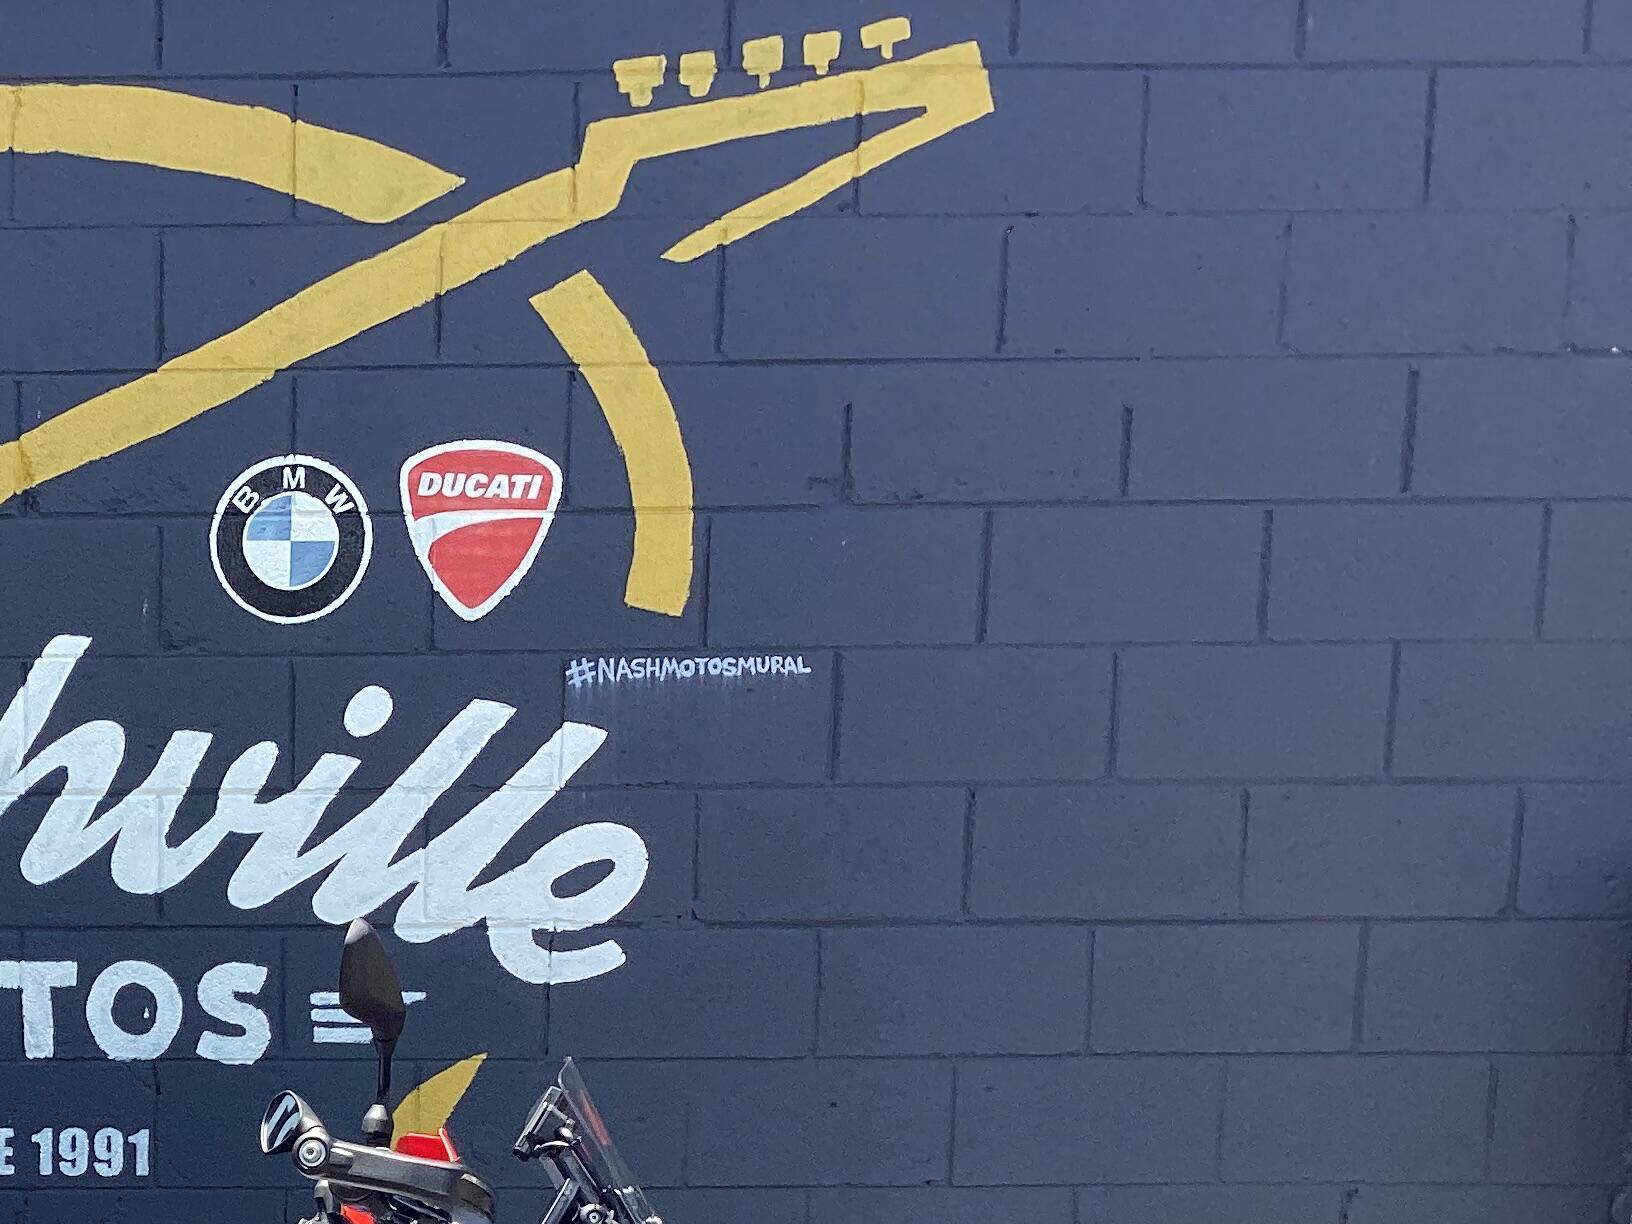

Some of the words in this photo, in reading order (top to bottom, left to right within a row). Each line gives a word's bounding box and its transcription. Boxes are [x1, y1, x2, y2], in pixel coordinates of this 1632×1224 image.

[232, 467, 355, 514] BMW
[418, 472, 543, 500] DUCATI
[565, 656, 812, 689] #NASHMOTOSMURAL
[32, 1127, 150, 1176] 1991
